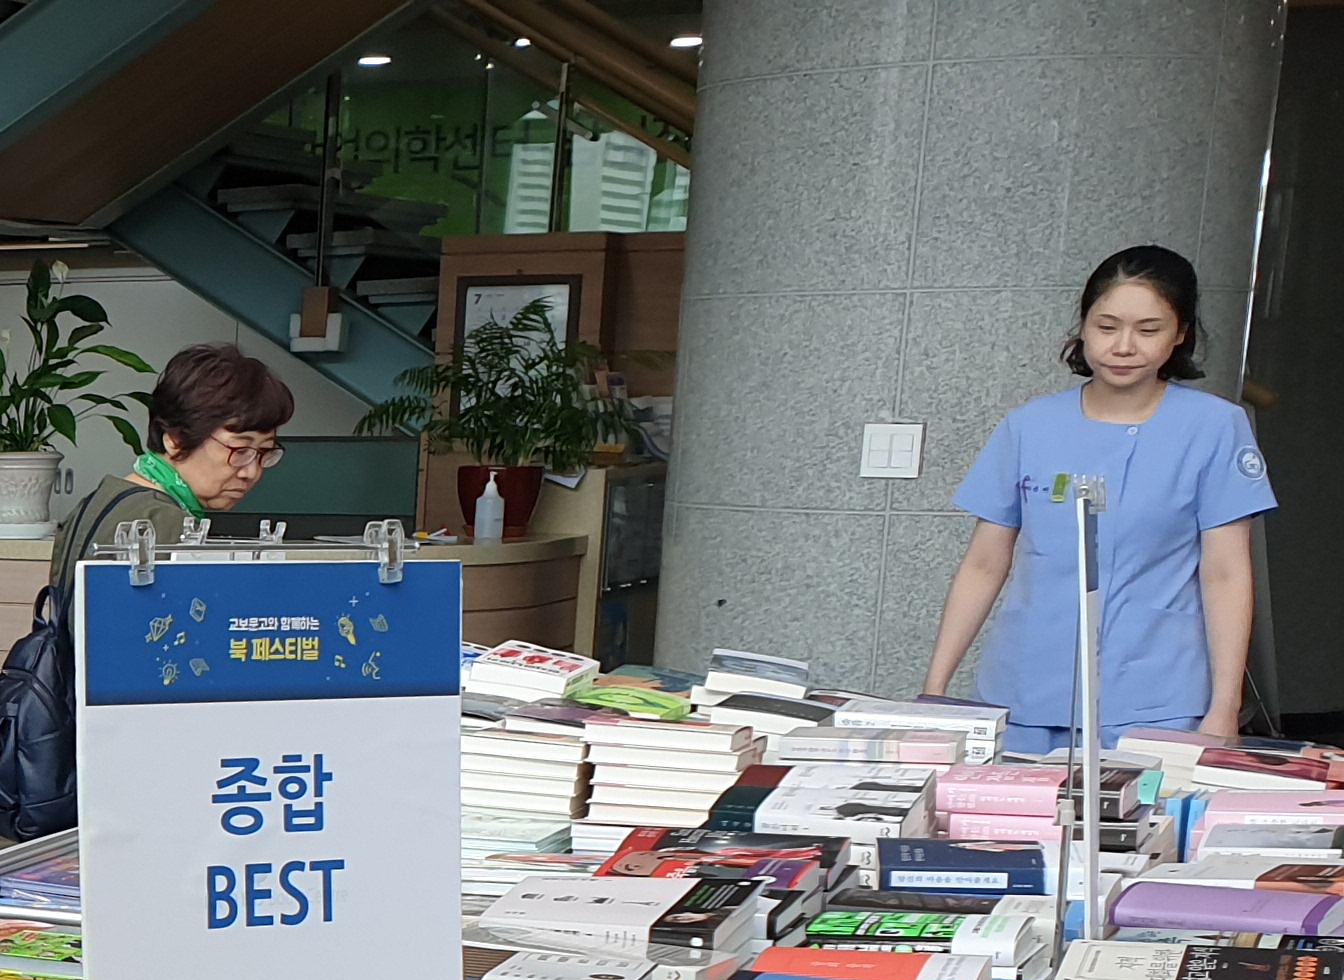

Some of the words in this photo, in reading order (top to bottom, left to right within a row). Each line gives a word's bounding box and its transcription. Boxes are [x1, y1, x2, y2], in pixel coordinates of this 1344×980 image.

[228, 617, 277, 632] 교보문고와
[280, 616, 320, 631] 함께하는
[228, 638, 247, 661] 북
[250, 635, 320, 661] 페스티벌
[211, 753, 333, 836] 종합
[206, 858, 346, 930] BEST
